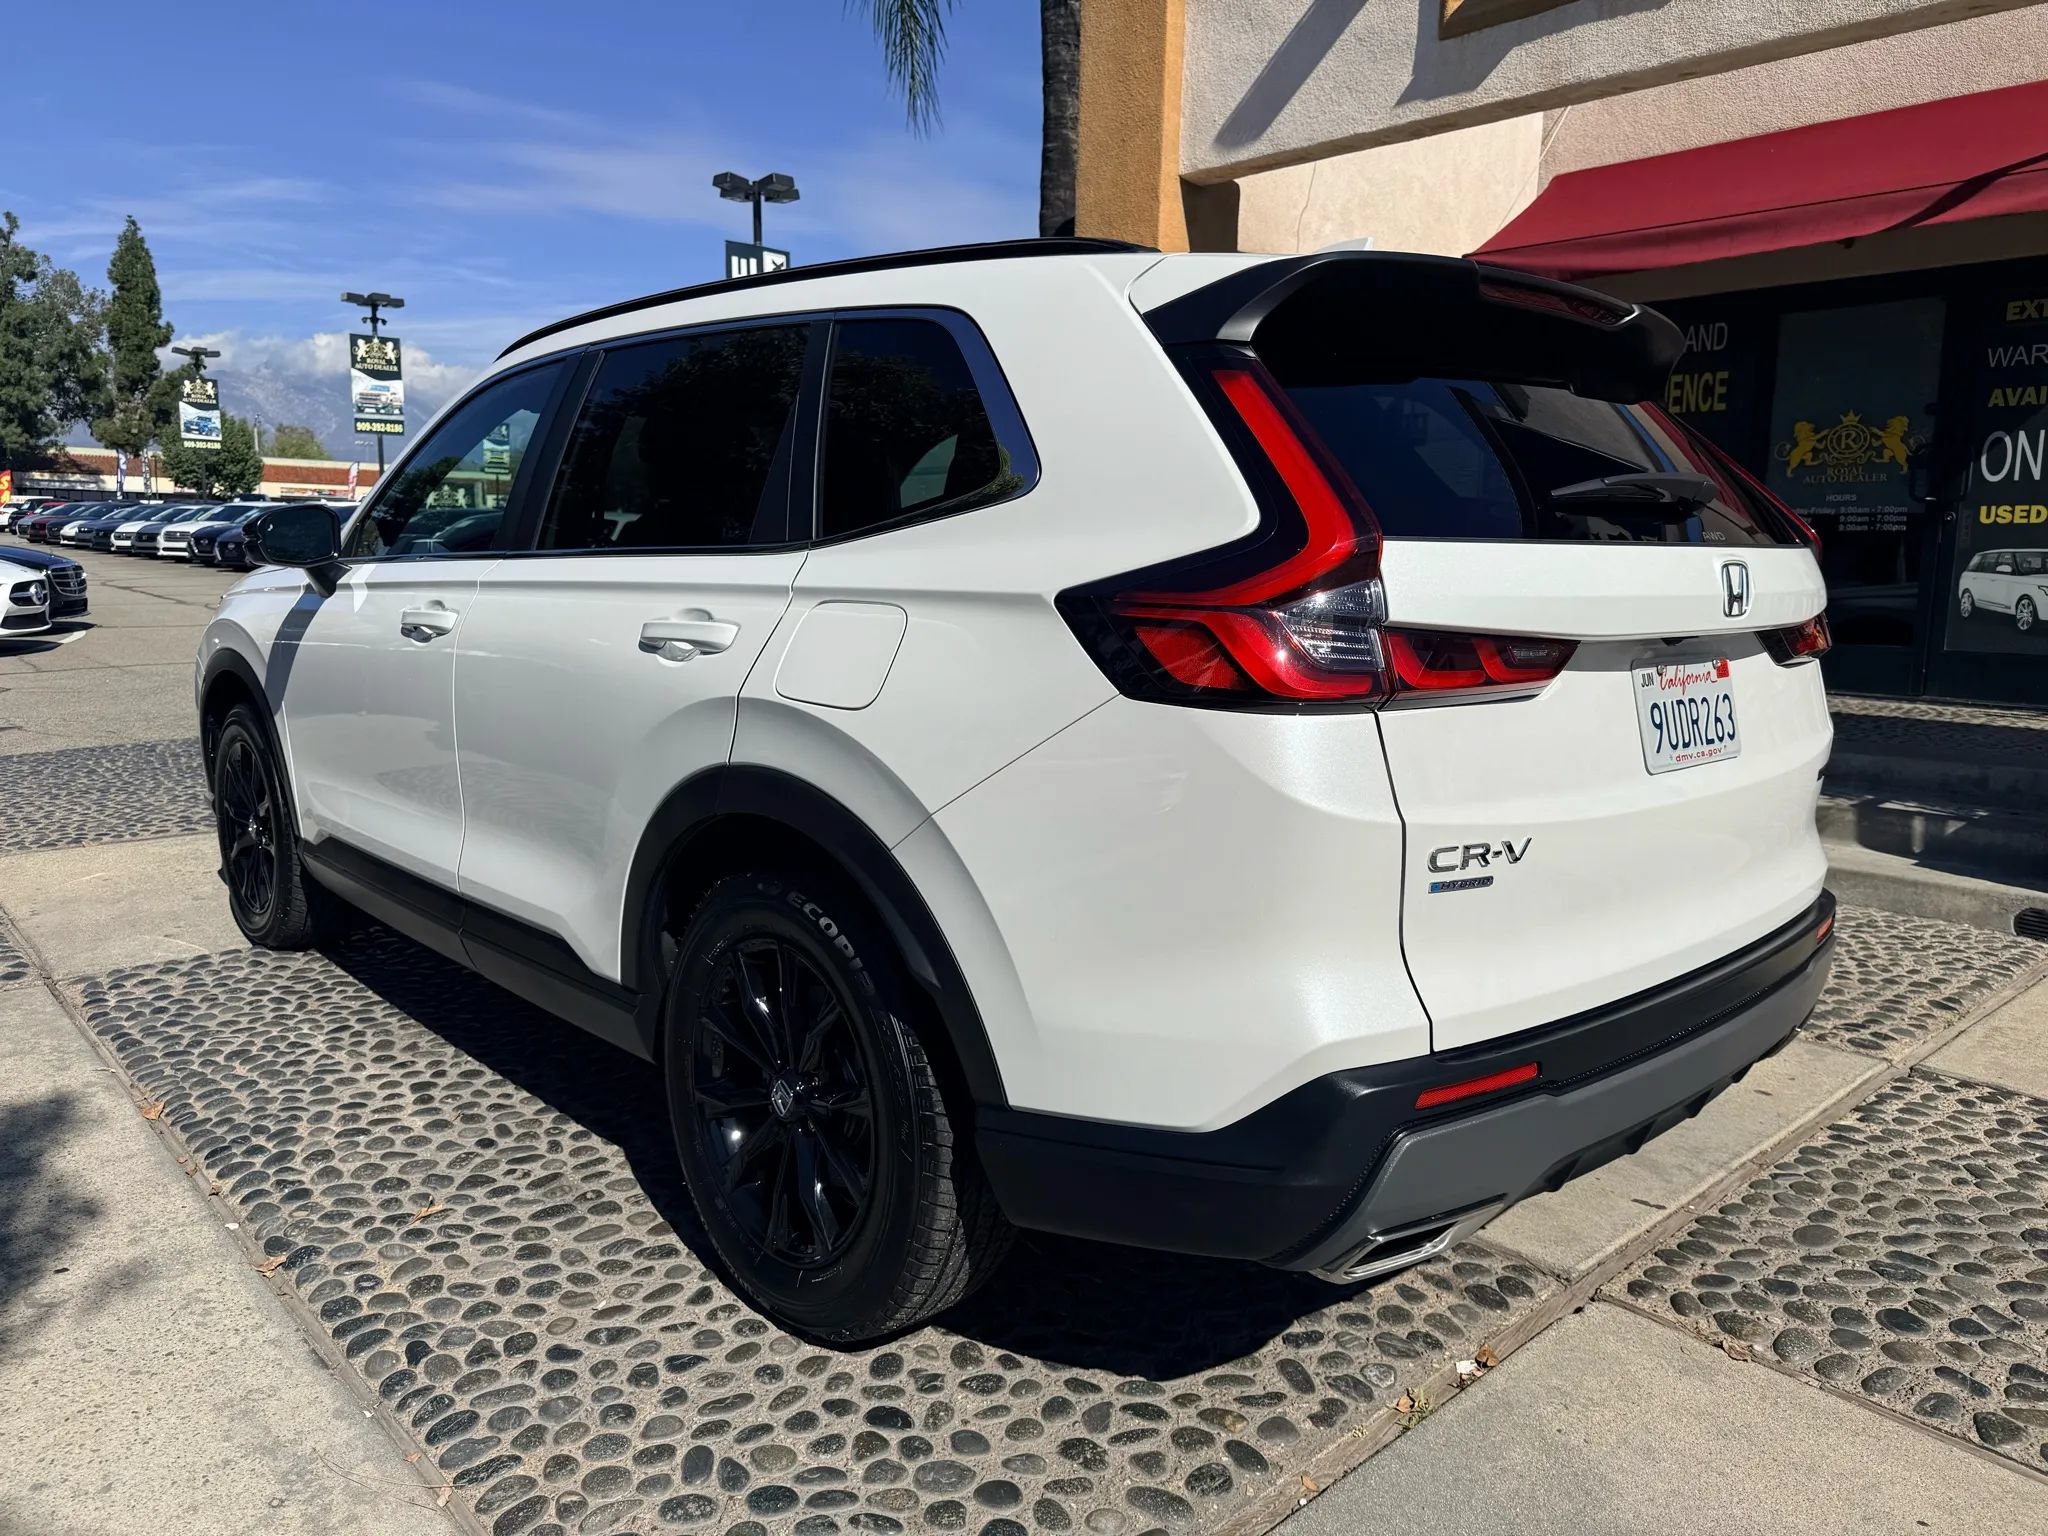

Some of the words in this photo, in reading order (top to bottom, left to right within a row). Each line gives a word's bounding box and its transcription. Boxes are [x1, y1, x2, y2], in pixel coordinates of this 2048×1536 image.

[1683, 322, 1728, 352] AND
[1988, 344, 2048, 367] WAR
[1668, 371, 1729, 413] ENCE
[1981, 430, 2045, 482] ON
[1803, 473, 1837, 484] AUTO
[1839, 473, 1888, 483] DEALER
[1826, 465, 1865, 476] ROYAL
[1825, 494, 1857, 502] HOURS
[1979, 505, 2048, 524] USED
[1641, 672, 1655, 688] JUN
[1659, 664, 1717, 696] California
[1650, 693, 1736, 754] 9UDR263
[1675, 747, 1722, 762] dmv.ca.gov
[1427, 837, 1533, 873] CR-V
[1439, 877, 1492, 891] HYBRID
